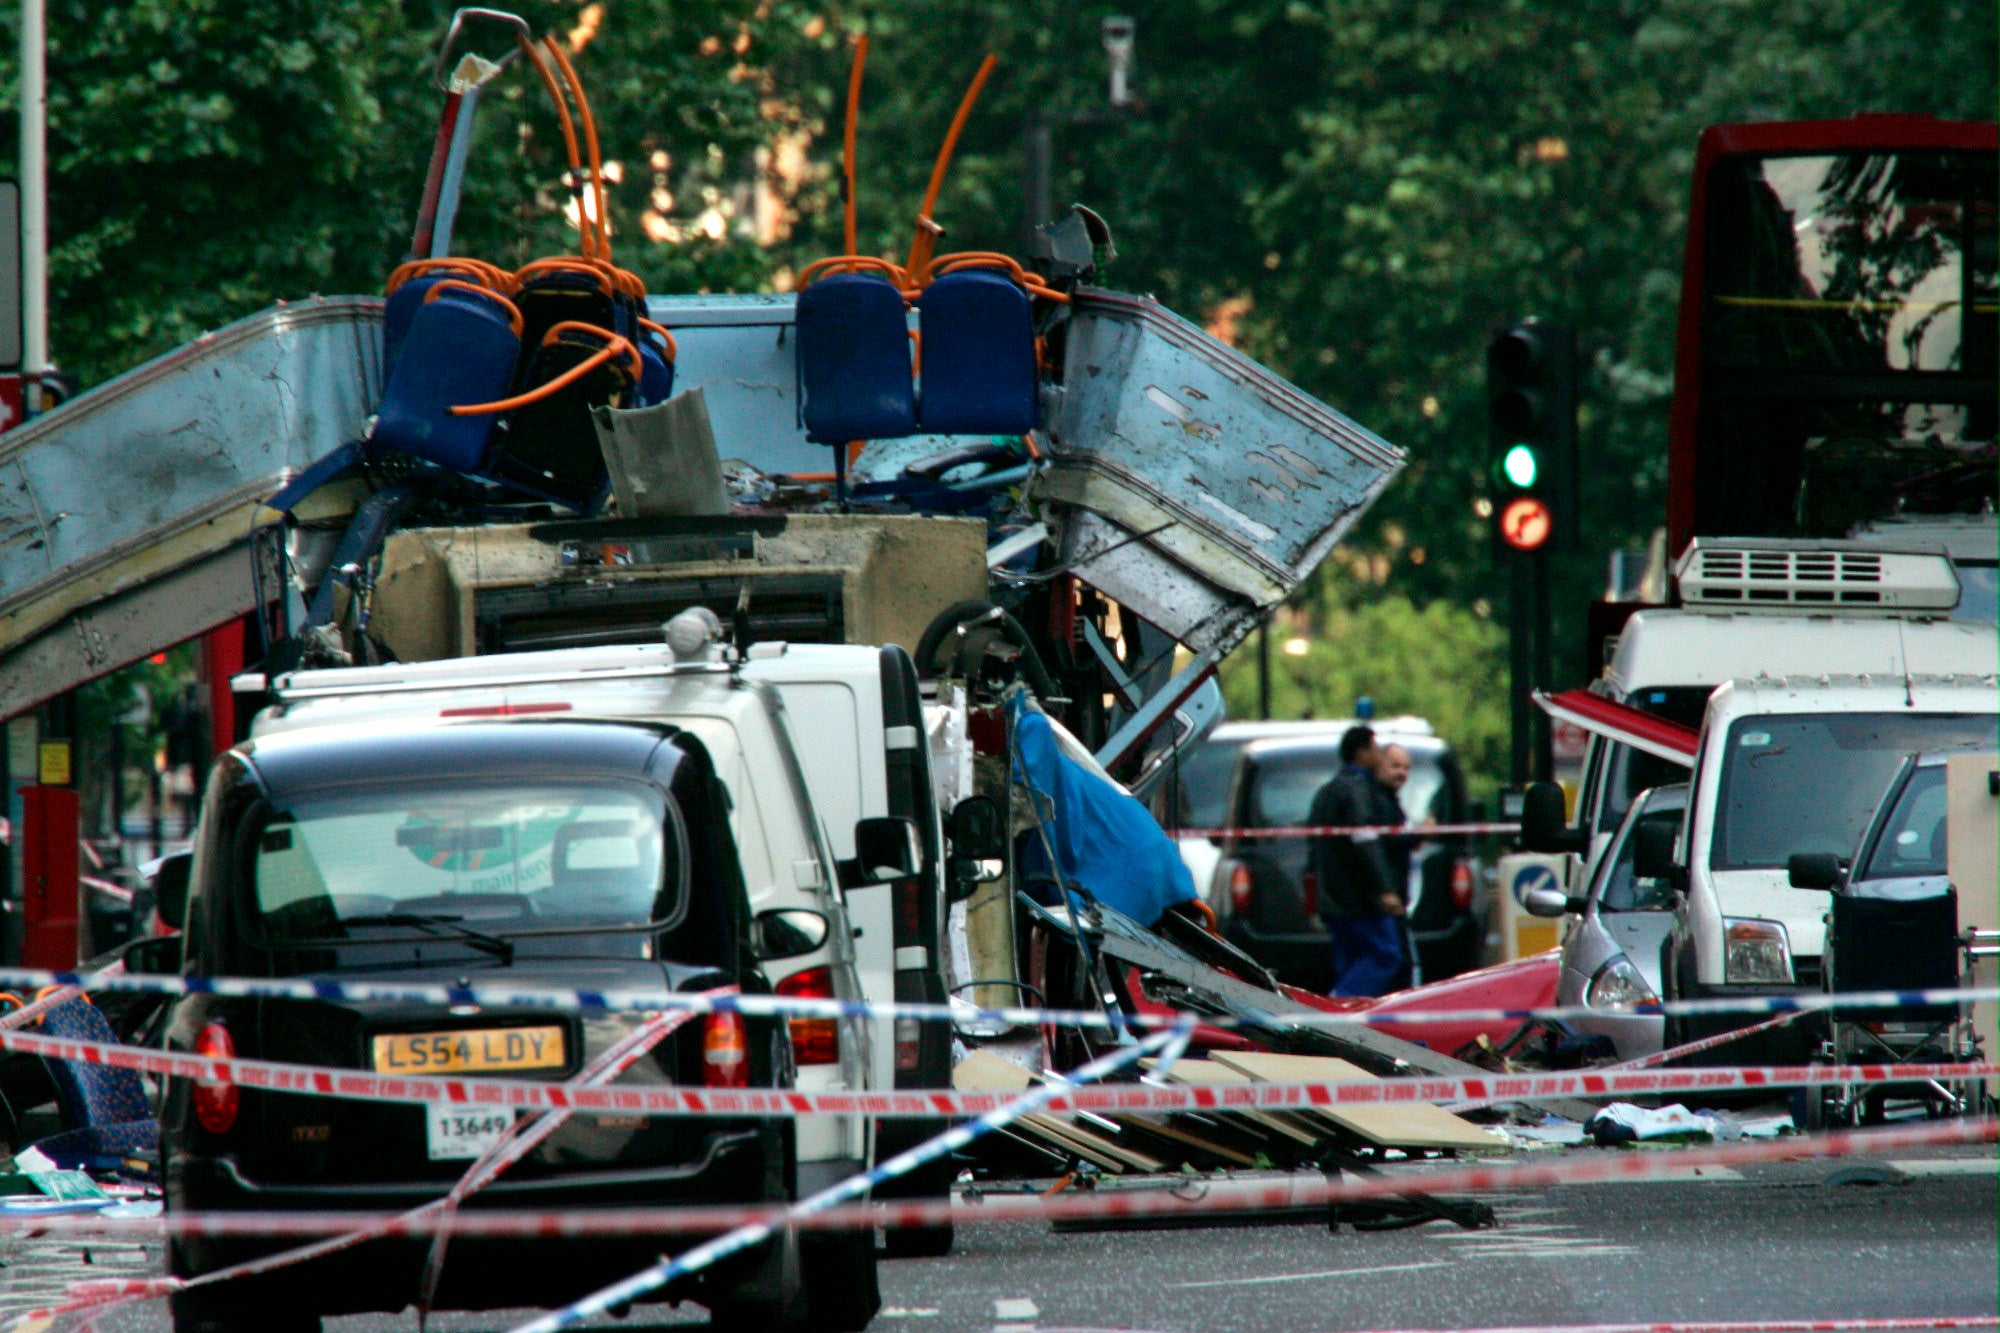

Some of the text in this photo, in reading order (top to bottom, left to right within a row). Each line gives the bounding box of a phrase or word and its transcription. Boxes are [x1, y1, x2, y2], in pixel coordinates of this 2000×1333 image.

[388, 1032, 546, 1068] LS54 LDY
[440, 1115, 506, 1137] 13649
